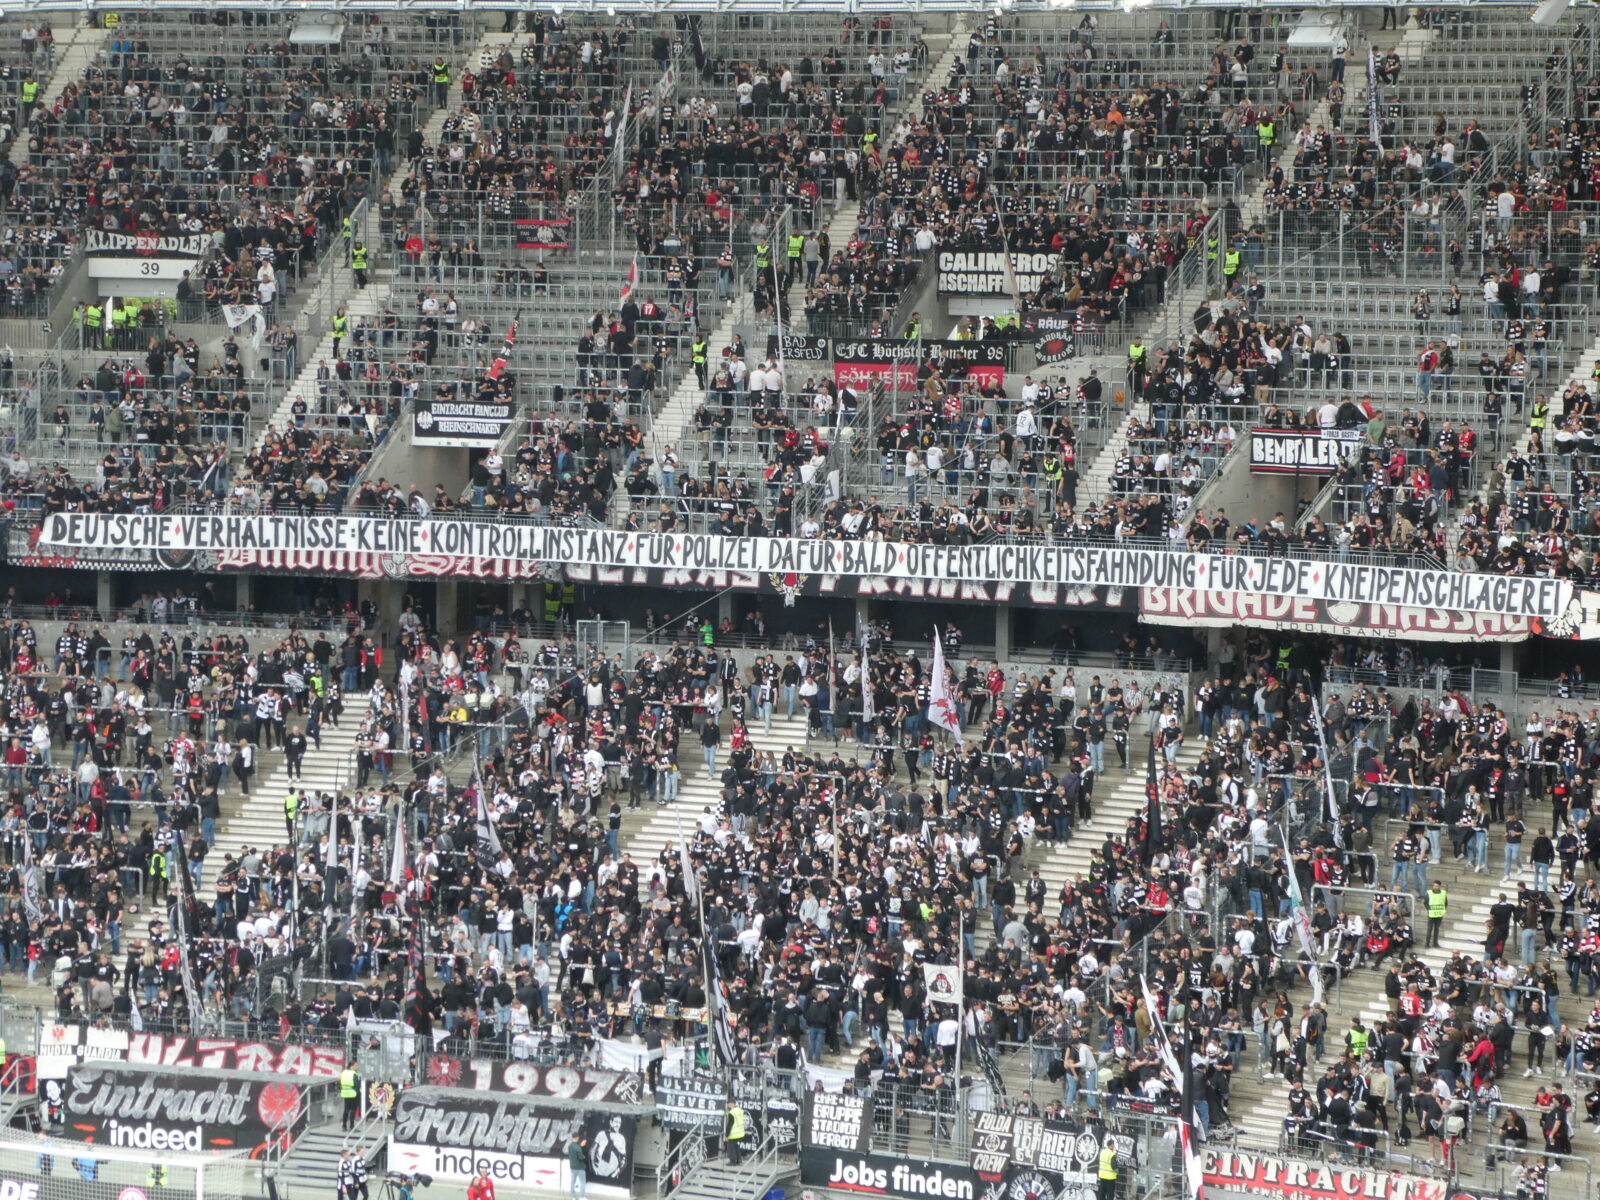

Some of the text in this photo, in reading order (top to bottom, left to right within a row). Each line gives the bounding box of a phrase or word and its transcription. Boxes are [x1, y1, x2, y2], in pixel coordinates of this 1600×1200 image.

[85, 228, 213, 255] KLIPPENADLER
[141, 262, 160, 275] 39
[783, 337, 806, 348] BAD
[836, 343, 868, 359] EFC
[775, 347, 822, 360] HERSFELD
[431, 403, 509, 417] EINTRACHT FANCLUB
[438, 421, 500, 434] RHEINSCHNAKEN
[51, 514, 171, 547] DEUTSCHE
[358, 519, 421, 552] KEINE
[430, 522, 627, 564] KONTROLLINSTANZ
[635, 533, 676, 566] FÜR
[768, 538, 836, 572] DAFÜR
[843, 541, 897, 574] BALD
[1209, 557, 1249, 591] FÜR
[1253, 558, 1311, 595] JEDE
[1324, 564, 1560, 617] KNEIPENSCHLÄGEREI
[1142, 585, 1319, 621] BRIGADE
[40, 1044, 121, 1060] NUOVA GUARDIA
[127, 1033, 345, 1077] ULTRAS
[470, 1059, 619, 1101] 1997
[663, 1077, 723, 1094] ULTRAS
[67, 1070, 251, 1125] Eintracht
[666, 1094, 717, 1110] NEVER
[813, 1104, 863, 1123] GRUPPE
[977, 1112, 1012, 1133] FULDA
[109, 1118, 203, 1151] indeed
[394, 1099, 585, 1155] Frankfurt
[811, 1119, 861, 1136] STADION
[811, 1131, 859, 1150] VERBOT
[1040, 1131, 1076, 1157] RIED
[435, 1149, 525, 1181] indeed
[973, 1153, 1007, 1173] CREW
[1038, 1153, 1073, 1172] GEBIET
[830, 1158, 888, 1189] Jobs
[891, 1165, 974, 1200] finden
[1201, 1148, 1413, 1200] EINTRACHT
